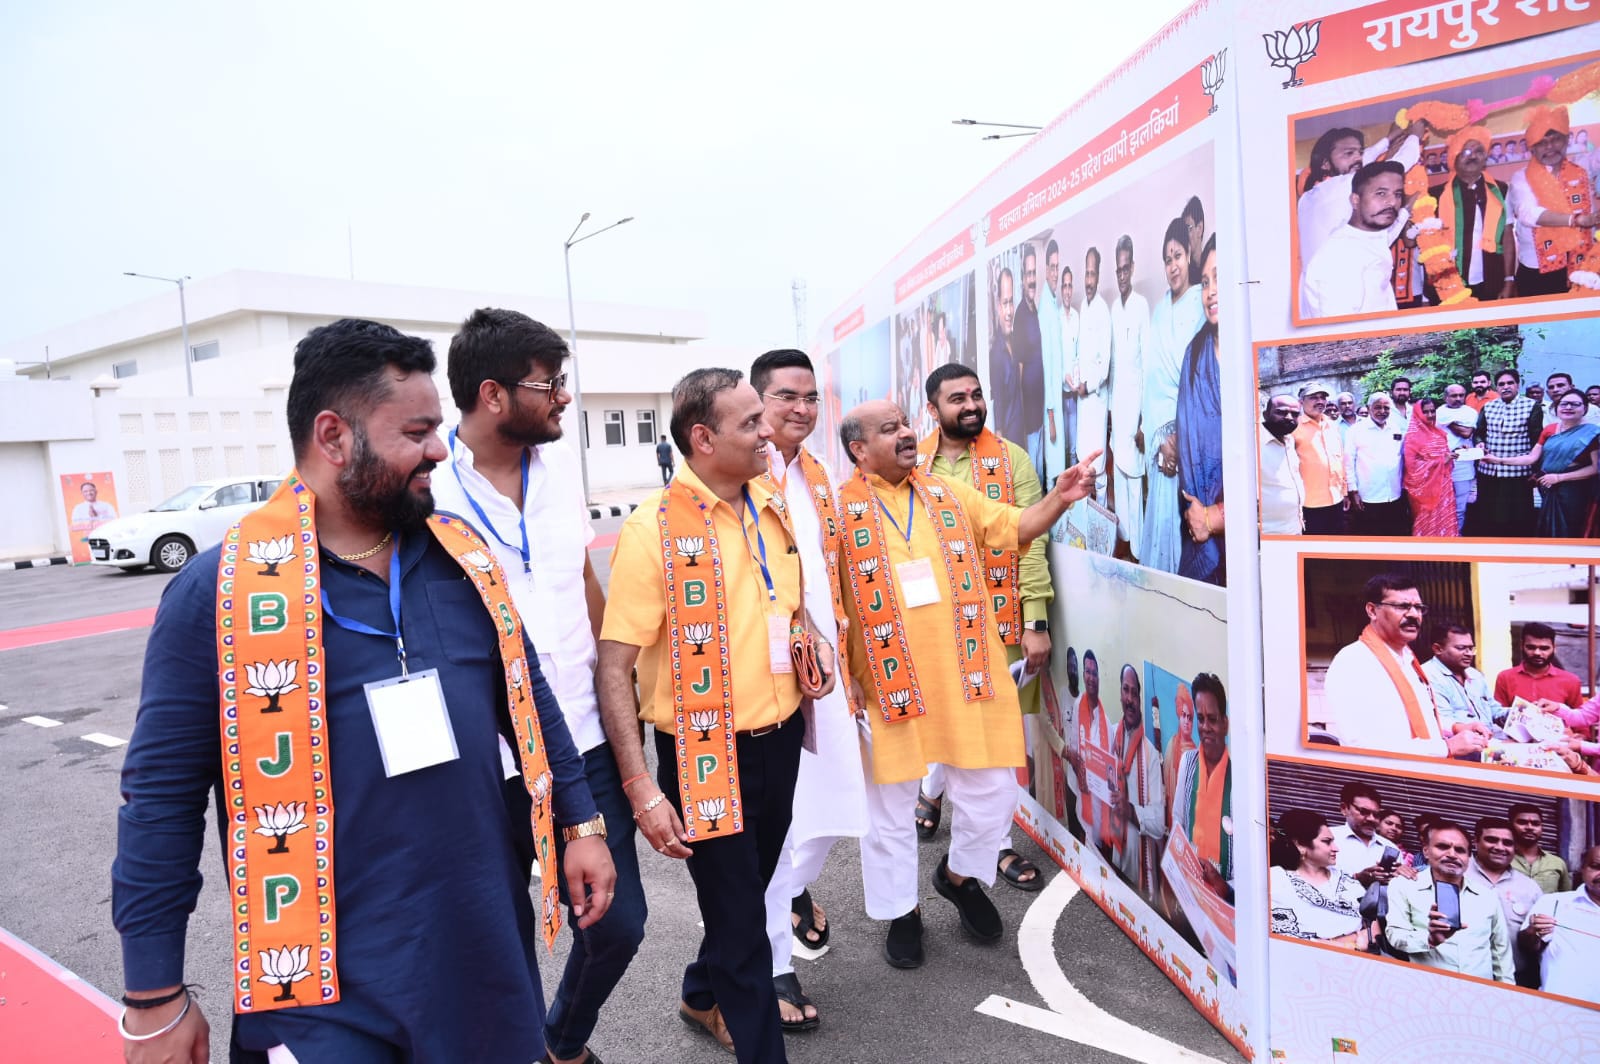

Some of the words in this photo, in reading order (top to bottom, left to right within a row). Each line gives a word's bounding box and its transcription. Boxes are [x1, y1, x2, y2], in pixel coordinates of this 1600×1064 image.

[1363, 0, 1499, 51] रायपुर
[1047, 168, 1080, 203] 2024-25
[1081, 153, 1101, 182] प्रदेश
[1102, 130, 1128, 166] व्यापी
[1128, 95, 1180, 156] झलकियां
[986, 483, 1002, 500] B
[940, 510, 957, 528] B
[683, 579, 707, 608] B
[960, 571, 973, 592] J
[247, 592, 289, 636] B
[853, 527, 872, 549] B
[868, 589, 884, 613] J
[881, 657, 899, 681] P
[992, 595, 1007, 613] P
[965, 638, 978, 661] P
[690, 666, 712, 696] J
[498, 602, 515, 638] B
[525, 716, 536, 757] J
[539, 833, 549, 874] P
[256, 732, 293, 778] J
[695, 754, 719, 784] P
[262, 873, 300, 924] P
